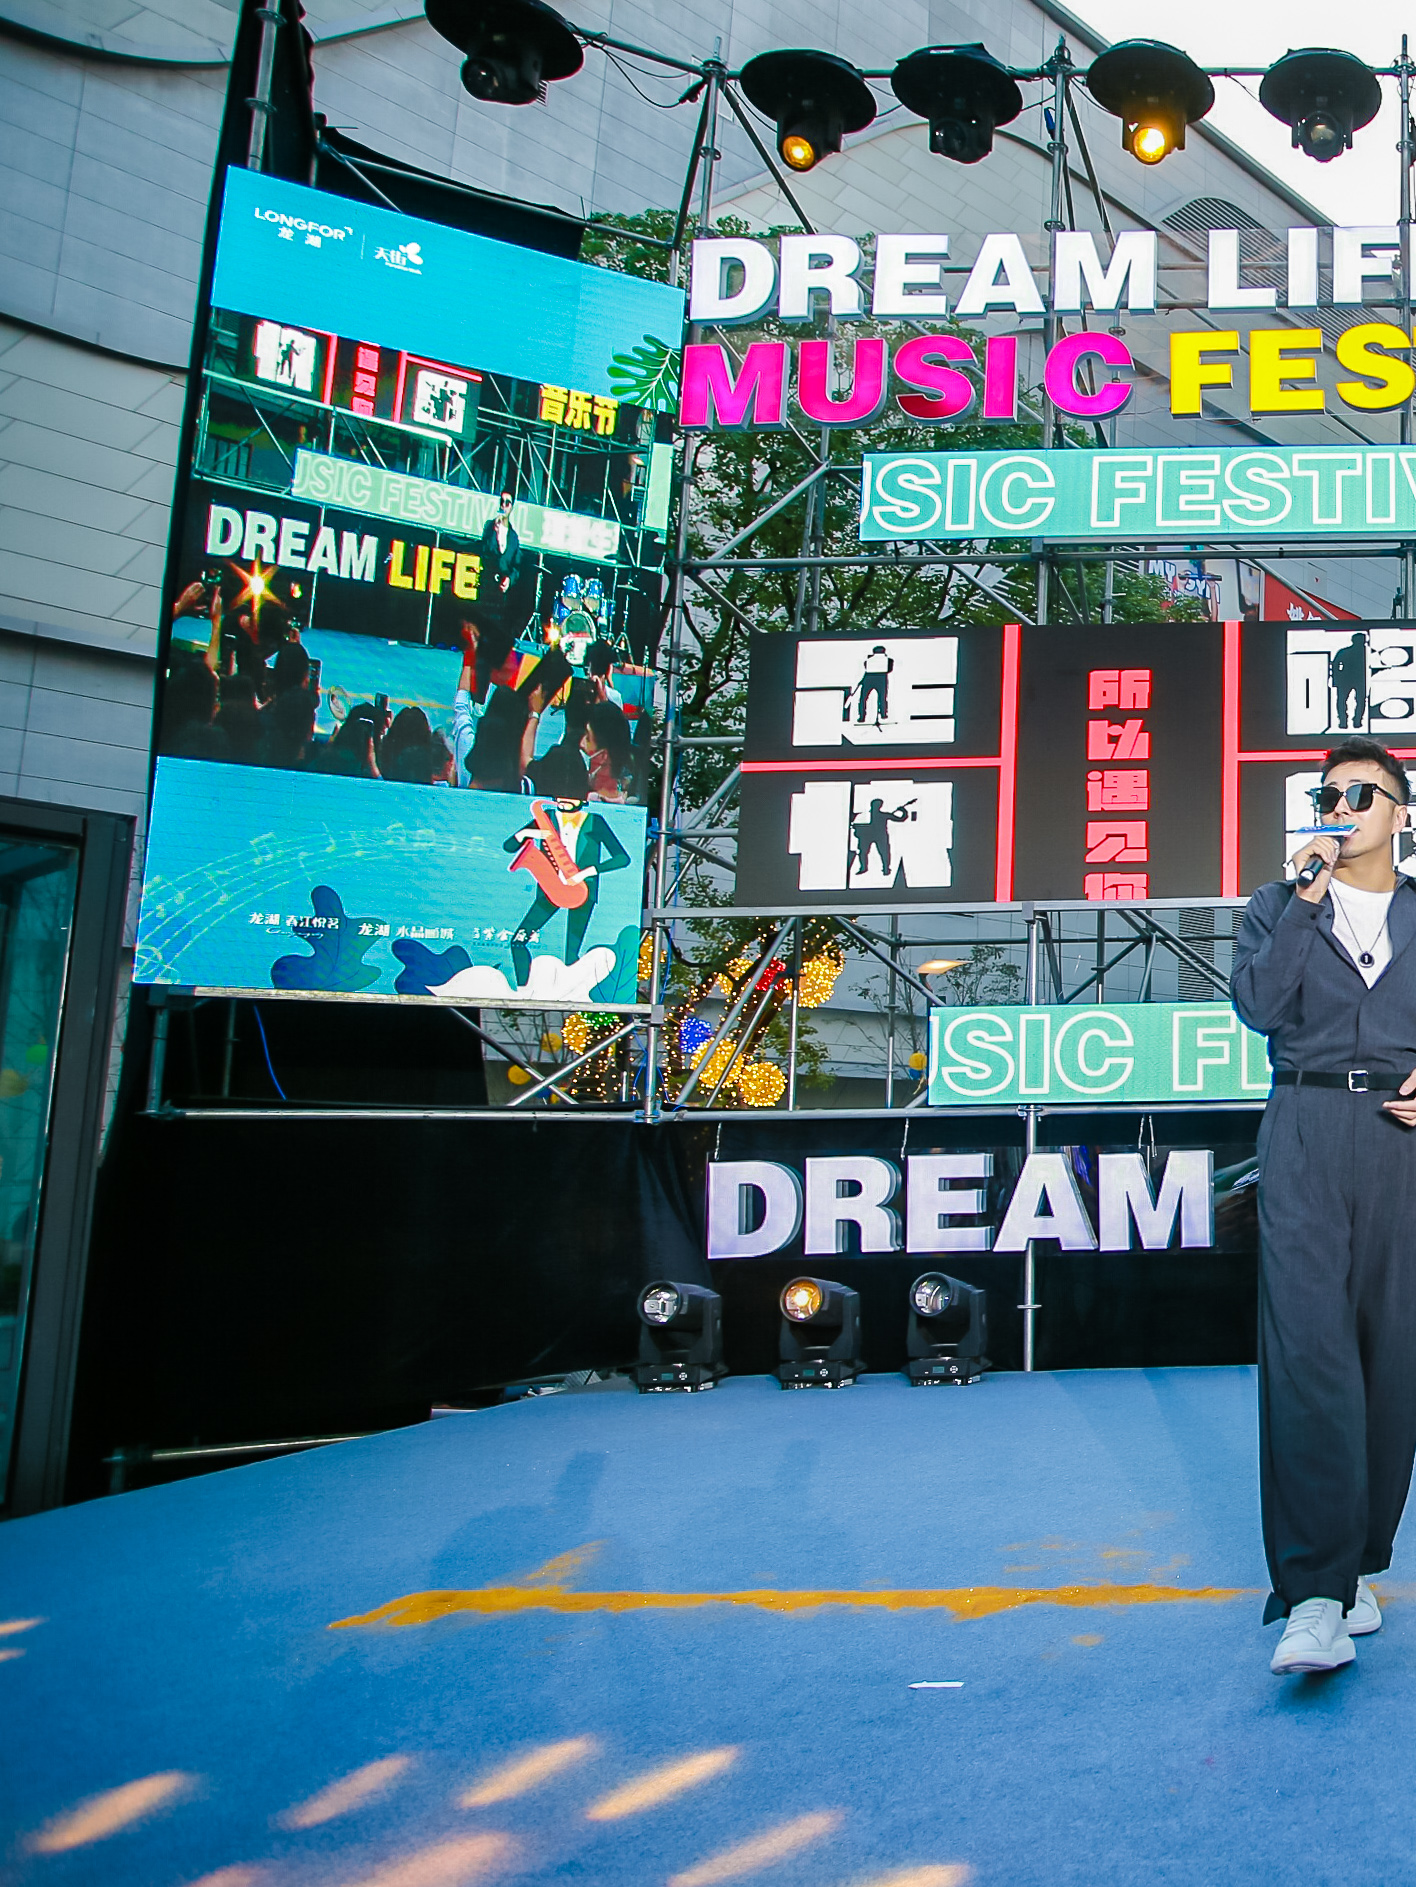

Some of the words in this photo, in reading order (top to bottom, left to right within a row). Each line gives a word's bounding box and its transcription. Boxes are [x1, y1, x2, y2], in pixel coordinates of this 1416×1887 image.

[254, 206, 346, 242] LONGFOR
[689, 230, 1158, 325] DREAM
[539, 384, 620, 436] 音乐节
[679, 331, 1136, 431] MUSIC
[206, 504, 380, 584] DREAM
[386, 537, 482, 602] LIFE
[706, 1148, 1215, 1260] DREAM
